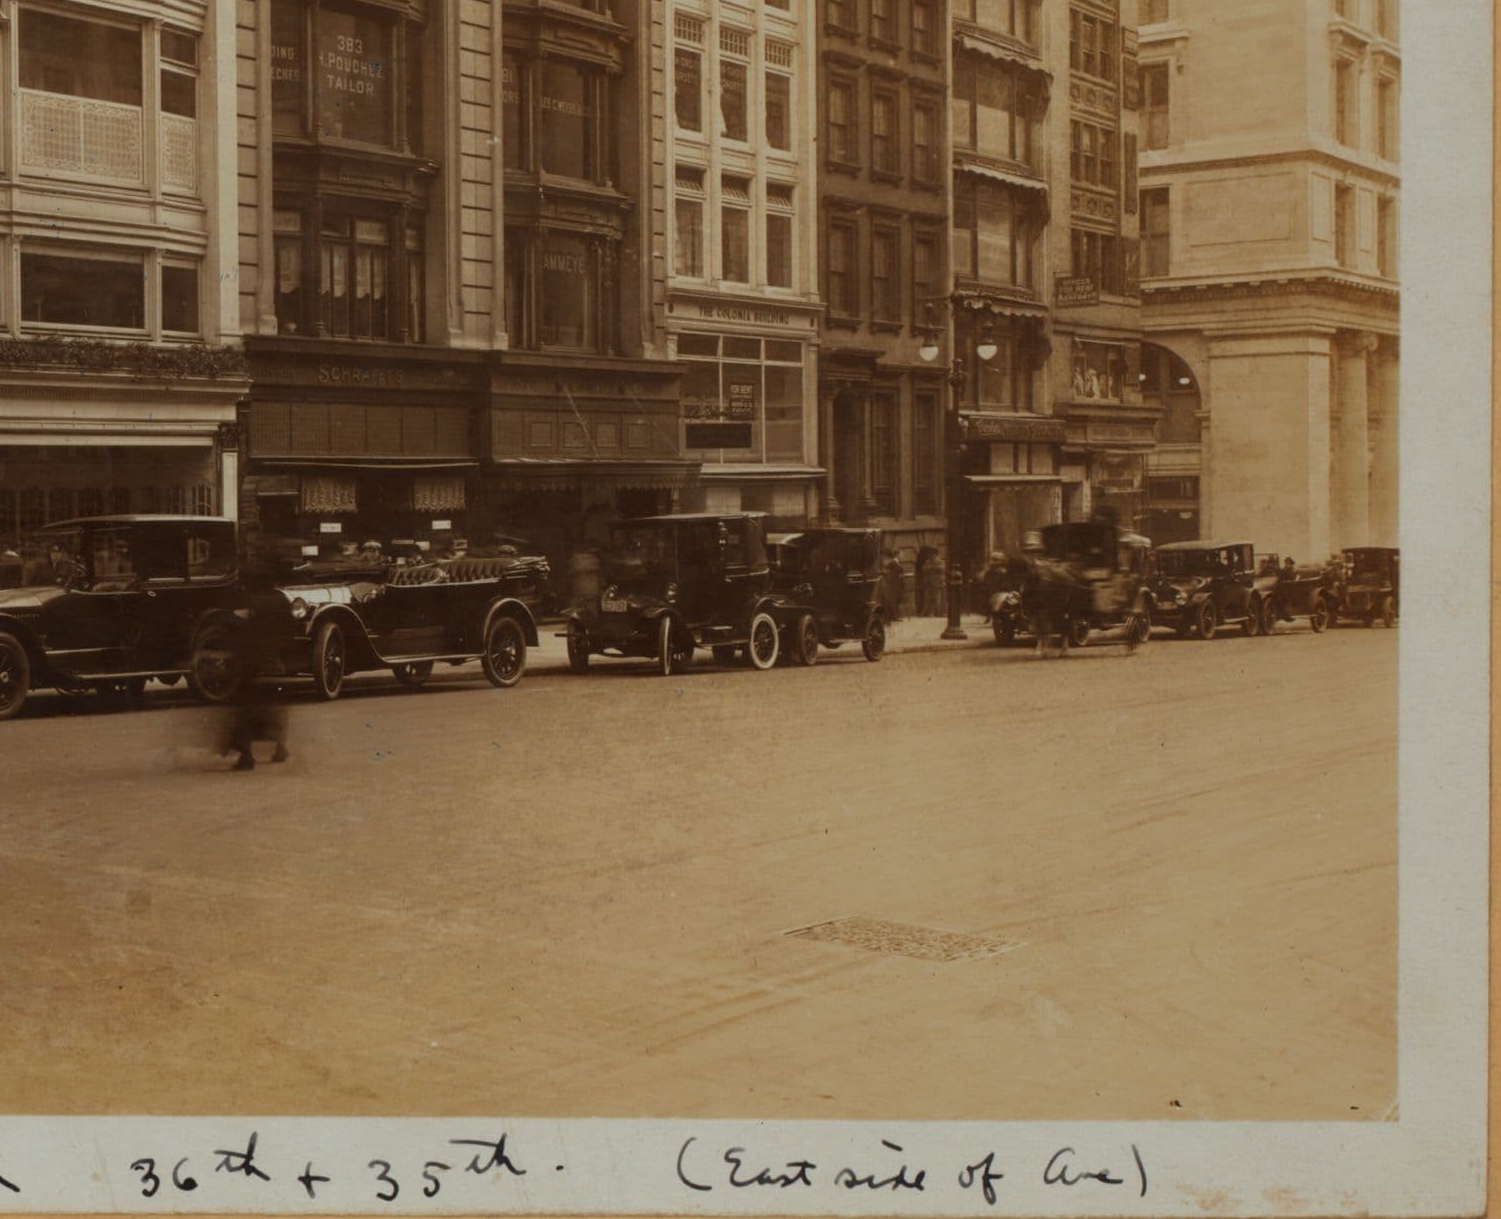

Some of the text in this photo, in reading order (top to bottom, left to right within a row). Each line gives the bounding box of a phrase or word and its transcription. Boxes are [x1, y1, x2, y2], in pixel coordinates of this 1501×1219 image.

[336, 34, 363, 55] 383
[326, 72, 375, 96] TAILOR
[130, 1132, 271, 1198] 36th
[834, 1139, 926, 1192] side
[958, 1152, 1004, 1205] of
